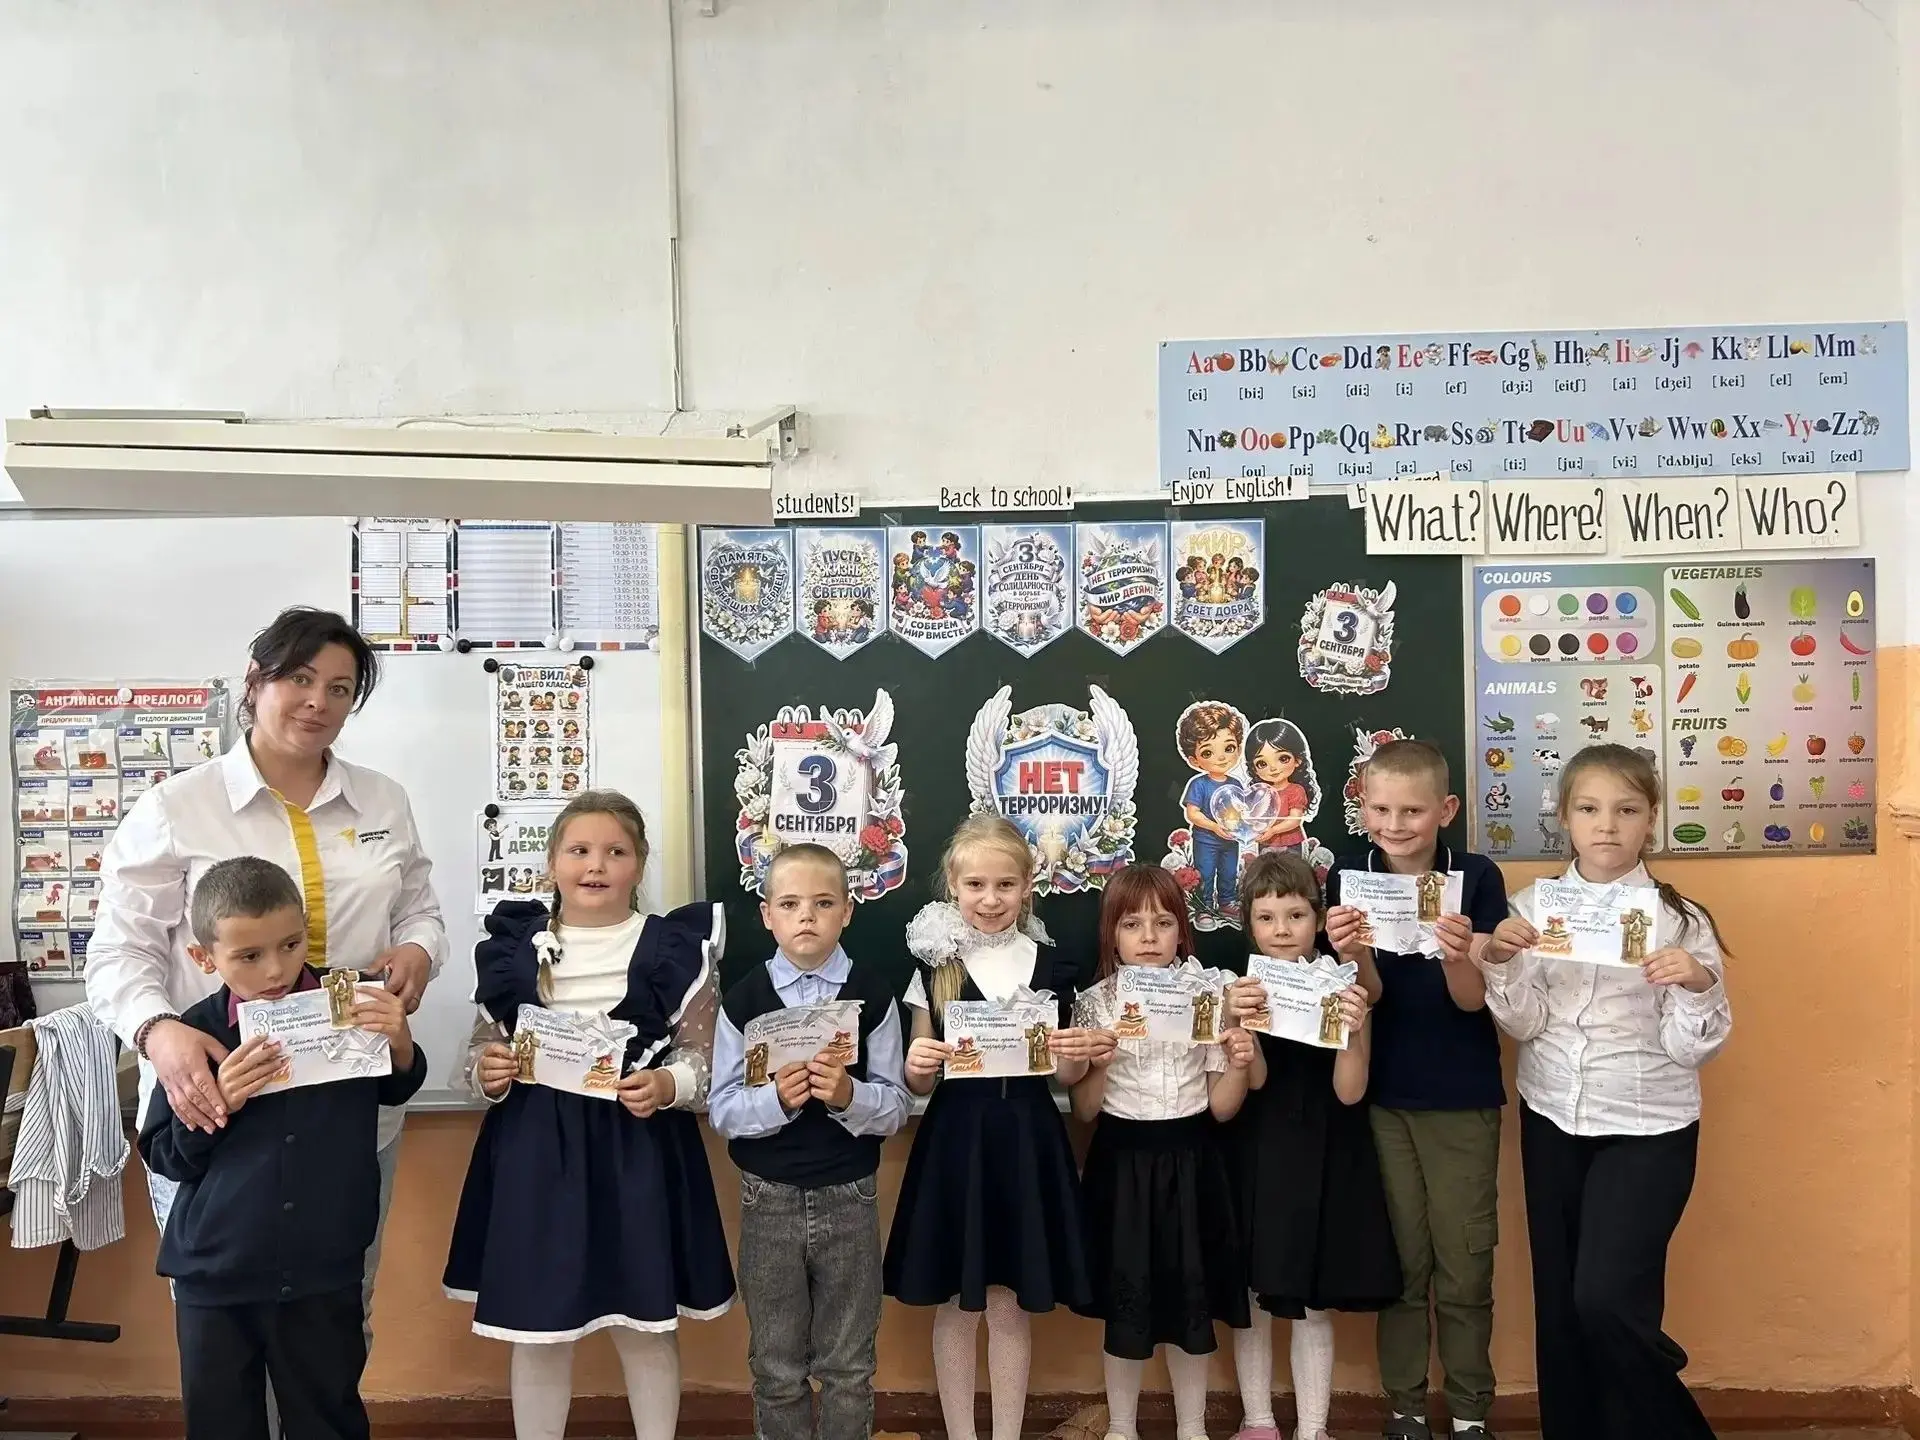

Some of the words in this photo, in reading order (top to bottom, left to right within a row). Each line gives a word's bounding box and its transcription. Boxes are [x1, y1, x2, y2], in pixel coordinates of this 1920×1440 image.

[1186, 351, 1214, 374] Aa
[1239, 348, 1266, 373] Bb
[1292, 346, 1318, 370] Cc
[1343, 344, 1372, 369] Dd
[1398, 344, 1424, 368] Ee
[1447, 342, 1472, 366] Ff
[1500, 340, 1530, 372] Gg
[1554, 340, 1584, 364] Hh
[1615, 338, 1631, 363] Ii
[1660, 336, 1680, 368] Jj
[1711, 336, 1743, 360] Kk
[1768, 334, 1789, 359] Ll
[1814, 333, 1856, 358] Mm
[1188, 388, 1206, 401] [ei]
[1239, 386, 1263, 400] [bi:]
[1292, 384, 1316, 398] [si:]
[1346, 383, 1370, 397] [di:]
[1446, 380, 1466, 394] [ef]
[1613, 376, 1636, 390] [ai]
[1770, 372, 1792, 387] [el]
[1819, 371, 1848, 386] [em]
[1186, 428, 1216, 454] Nn
[1240, 426, 1270, 452] Oo
[1288, 424, 1315, 456] Pp
[1339, 423, 1370, 454] Qq
[1394, 422, 1422, 447] Rr
[1451, 421, 1474, 446] Ss
[1502, 420, 1527, 444] Tt
[1556, 418, 1585, 444] Uu
[1608, 417, 1638, 442] Vv
[1666, 415, 1707, 440] Ww
[1732, 414, 1760, 438] Xx
[1784, 412, 1814, 442] Yy
[1832, 411, 1860, 436] Zz
[1188, 466, 1210, 480] [en]
[1338, 461, 1372, 476] [kju:]
[1450, 459, 1472, 472] [es]
[1504, 458, 1526, 471] [ti:]
[1612, 456, 1636, 469] [vi:]
[1731, 452, 1762, 466] [eks]
[1782, 450, 1814, 465] [wai]
[1830, 449, 1862, 463] [zed]
[940, 487, 984, 508] Back
[990, 491, 1008, 508] to
[1012, 486, 1072, 506] school!
[1226, 476, 1292, 502] English!
[776, 494, 855, 515] students!
[1492, 488, 1604, 542] Where?
[1622, 486, 1730, 542] When?
[1745, 480, 1846, 536] Who?
[1371, 489, 1482, 542] What?
[1189, 531, 1246, 552] МИР
[718, 551, 768, 566] ПАМЯТЬ
[822, 549, 862, 563] ПУСТЬ
[1018, 543, 1033, 562] 3
[1002, 564, 1044, 574] СЕНТЯБРЯ
[1014, 574, 1039, 582] ДЕНЬ
[1092, 572, 1106, 584] НЕТ
[1483, 571, 1552, 584] COLOURS
[1671, 567, 1763, 580] VEGETABLES
[710, 567, 722, 593] СВЕТ
[718, 591, 757, 614] НАШИХ
[762, 572, 786, 606] СЕРДЕЦ
[998, 582, 1054, 592] СОЛИДАРНОСТИ
[1098, 592, 1120, 604] МИР
[1122, 586, 1153, 599] ДЕТЯМ!
[1003, 600, 1050, 610] ТЕРРОРИЗМОМ
[1186, 604, 1212, 616] СВЕТ
[1215, 604, 1250, 618] ДОБРА
[904, 629, 924, 639] МИР
[926, 629, 966, 639] ВМЕСТЕ
[1333, 610, 1359, 644] 3
[1320, 640, 1365, 658] СЕНТЯБРЯ
[518, 670, 572, 682] ПРАВИЛА
[1484, 680, 1558, 695] ANIMALS
[44, 693, 130, 706] АНГЛИЙСКИ
[134, 694, 202, 706] ПРЕДЛОГИ
[1671, 718, 1728, 730] FRUITS
[796, 755, 837, 814] 3
[1019, 760, 1084, 794] НЕТ
[1000, 796, 1108, 815] ТЕРРОРИЗМУ!
[775, 813, 856, 834] СЕНТЯБРЯ
[1346, 875, 1360, 899] 3
[1540, 883, 1554, 908] 3
[1122, 968, 1136, 992] 3
[252, 1010, 270, 1036] 3
[950, 1004, 964, 1030] 3
[749, 1020, 762, 1041] 3
